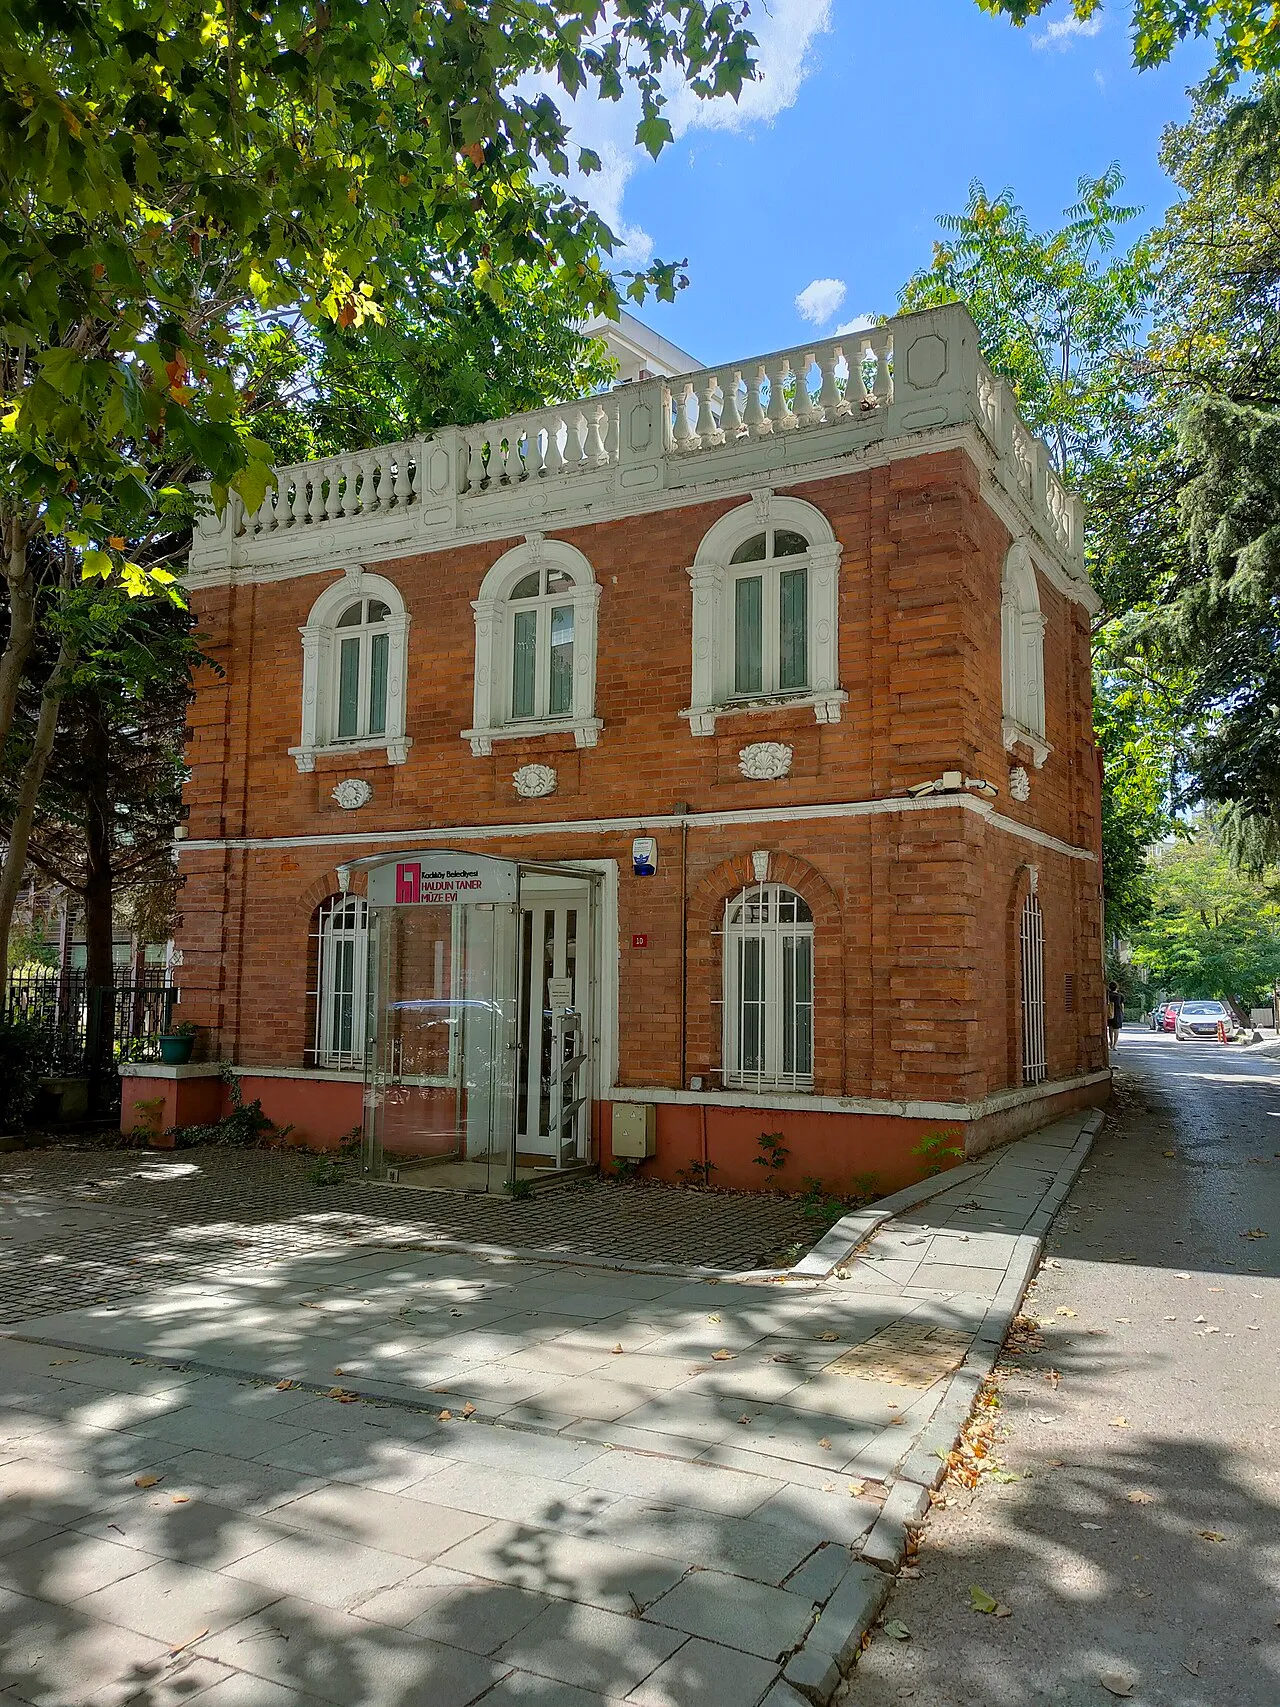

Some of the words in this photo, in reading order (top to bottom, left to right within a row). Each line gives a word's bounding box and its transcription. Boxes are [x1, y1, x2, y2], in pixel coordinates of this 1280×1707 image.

[421, 881, 454, 891] HALDUN
[455, 880, 482, 889] TANER
[421, 891, 444, 903] MÜZE
[444, 891, 458, 902] EVİ
